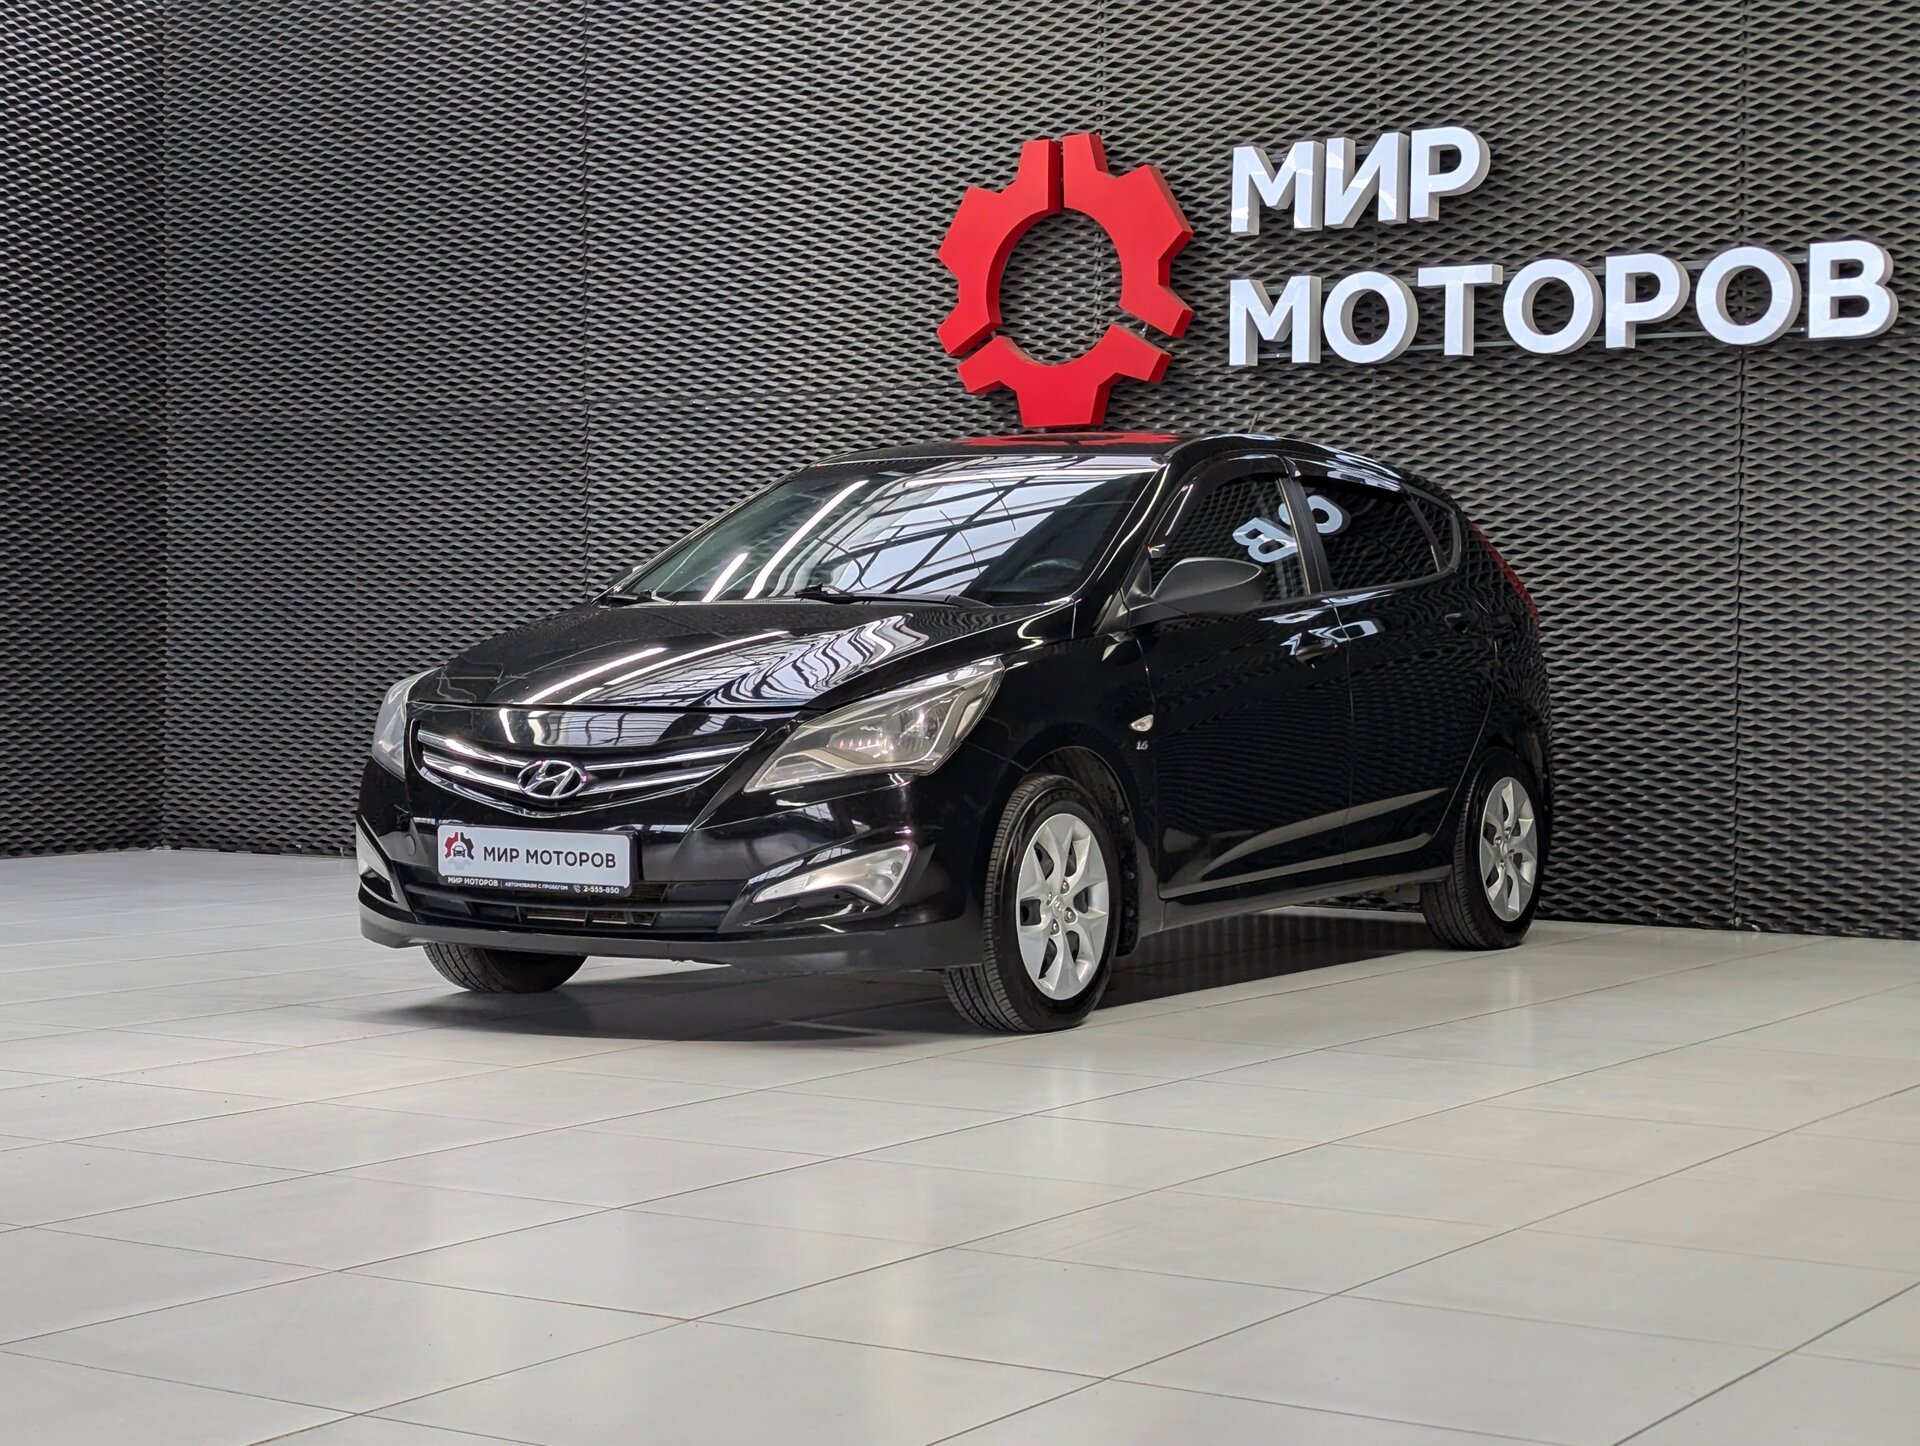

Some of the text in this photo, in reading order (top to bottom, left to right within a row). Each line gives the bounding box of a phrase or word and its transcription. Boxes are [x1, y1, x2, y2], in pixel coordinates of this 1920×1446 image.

[1230, 126, 1490, 235] МИР
[1229, 239, 1898, 366] МОТОРОВ
[483, 846, 616, 868] МИР МОТОРОВ
[447, 876, 498, 887] МИР МОТОРОВ
[583, 885, 620, 894] 2-555-850
